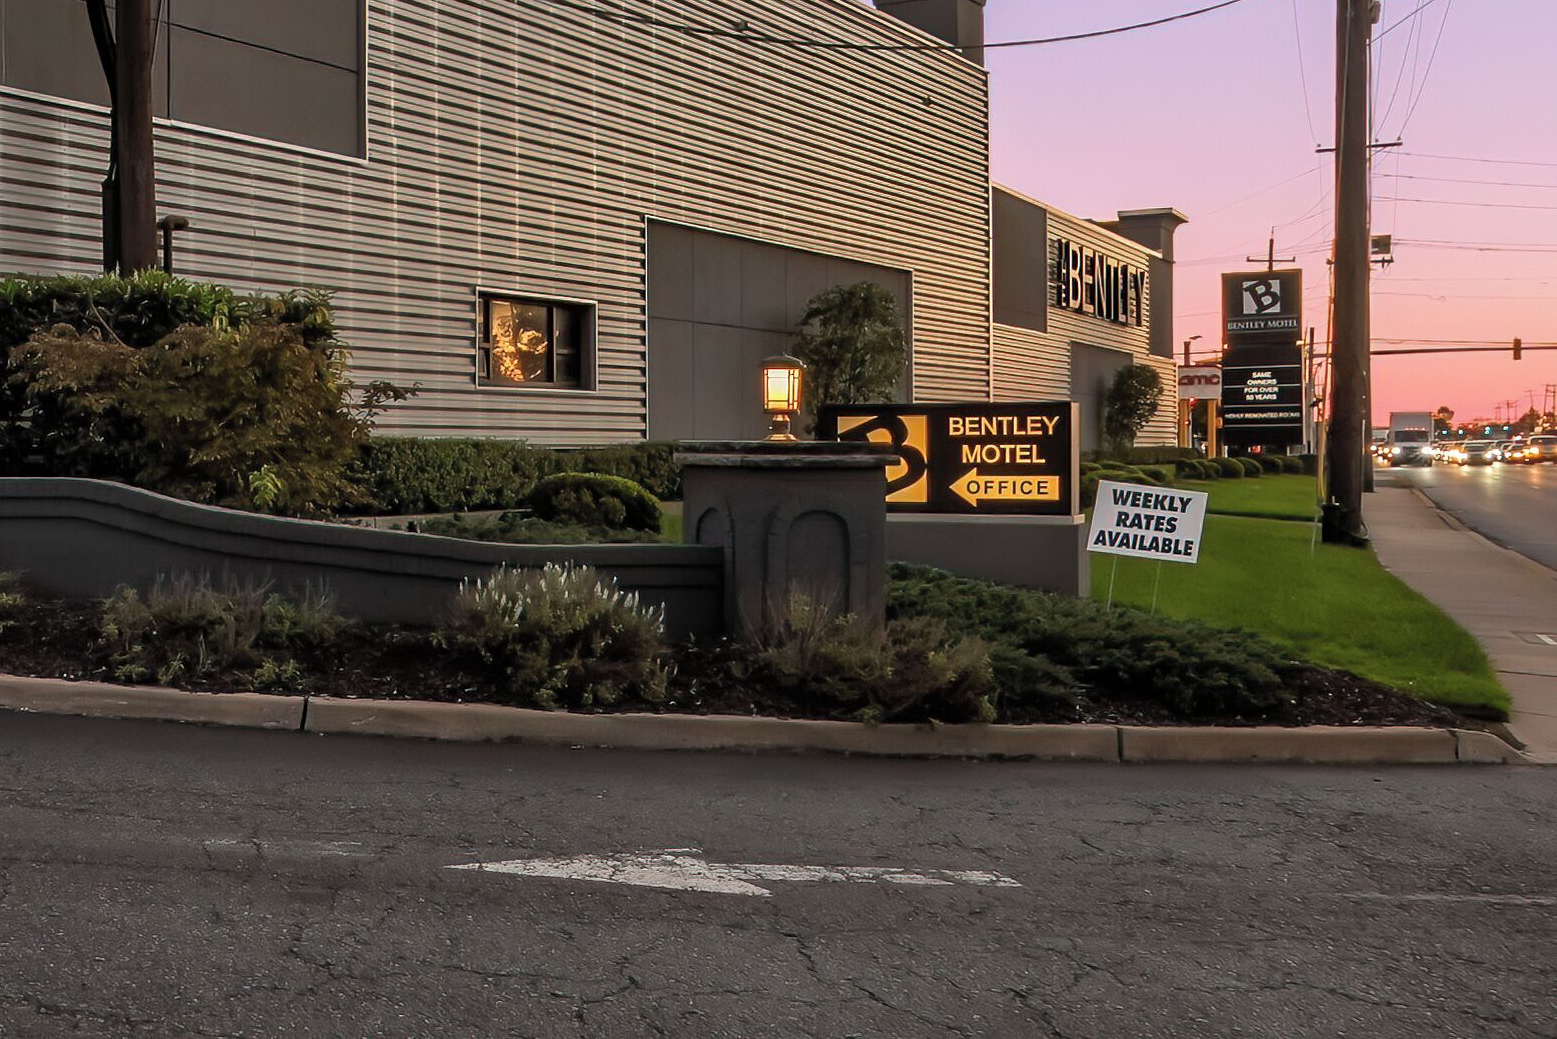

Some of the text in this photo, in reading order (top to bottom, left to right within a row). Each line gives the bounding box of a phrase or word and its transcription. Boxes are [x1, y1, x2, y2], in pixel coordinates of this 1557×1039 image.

[1068, 241, 1148, 327] BENTLEY
[1242, 279, 1281, 314] B
[1227, 319, 1297, 330] BENTLEY MOTEL
[1246, 378, 1277, 386] OWNERS
[949, 416, 1060, 436] BENTLEY
[962, 444, 1046, 464] MOTEL
[966, 480, 1049, 495] OFFICE
[1112, 488, 1193, 513] WEEKLY
[1115, 511, 1178, 533] RATES
[1093, 529, 1194, 556] AVAILABLE
